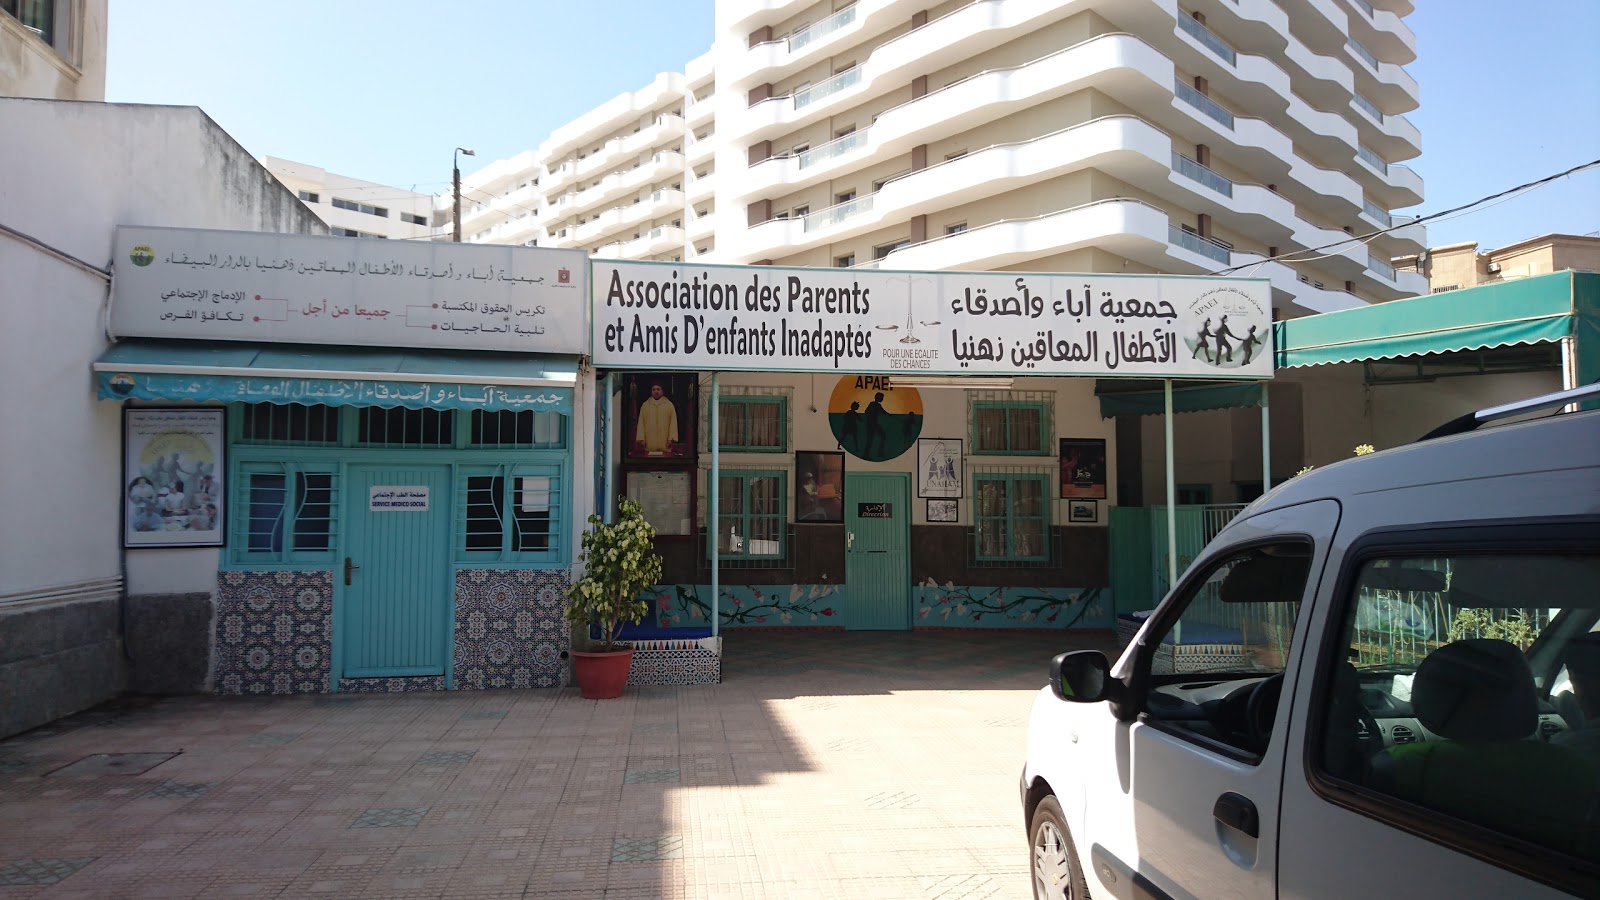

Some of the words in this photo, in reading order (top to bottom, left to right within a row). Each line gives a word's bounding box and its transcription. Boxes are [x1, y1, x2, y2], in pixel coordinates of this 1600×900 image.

[164, 252, 220, 270] البيضاء
[221, 254, 251, 272] بالدار
[255, 257, 294, 273] ذهنيا
[297, 261, 355, 275] المعاقين
[358, 260, 404, 276] الأطفال
[408, 262, 453, 279] أصدقاء
[498, 269, 545, 286] جمعية
[160, 288, 208, 303] الإجتماعي
[211, 290, 246, 304] الإدماج
[606, 269, 738, 308] Association
[745, 273, 781, 312] des
[787, 276, 870, 315] Parents
[951, 277, 1044, 319] وأصدقاء
[302, 298, 327, 318] أجل
[331, 305, 350, 318] من
[354, 303, 391, 321] جميعا
[441, 300, 478, 314] المكتسبة
[480, 302, 513, 318] الحقوق
[515, 304, 546, 317] تكريس
[1052, 284, 1091, 323] آباء
[1099, 291, 1177, 324] جمعية
[1194, 298, 1218, 317] APAEI
[159, 309, 197, 322] الفرص
[440, 321, 511, 335] الحاجيات
[513, 324, 545, 338] تلبية
[604, 316, 625, 352] et
[629, 313, 678, 354] Amis
[781, 317, 872, 368] Inadaptés
[1105, 328, 1177, 370] الأطفال
[882, 348, 900, 358] POUR
[901, 349, 914, 359] UNE
[914, 349, 939, 359] EGALITE
[1010, 330, 1098, 369] المعاقين
[890, 359, 901, 369] DES
[902, 359, 931, 369] CHANCES
[366, 382, 431, 403] أصدقاء
[498, 389, 564, 407] جمعية
